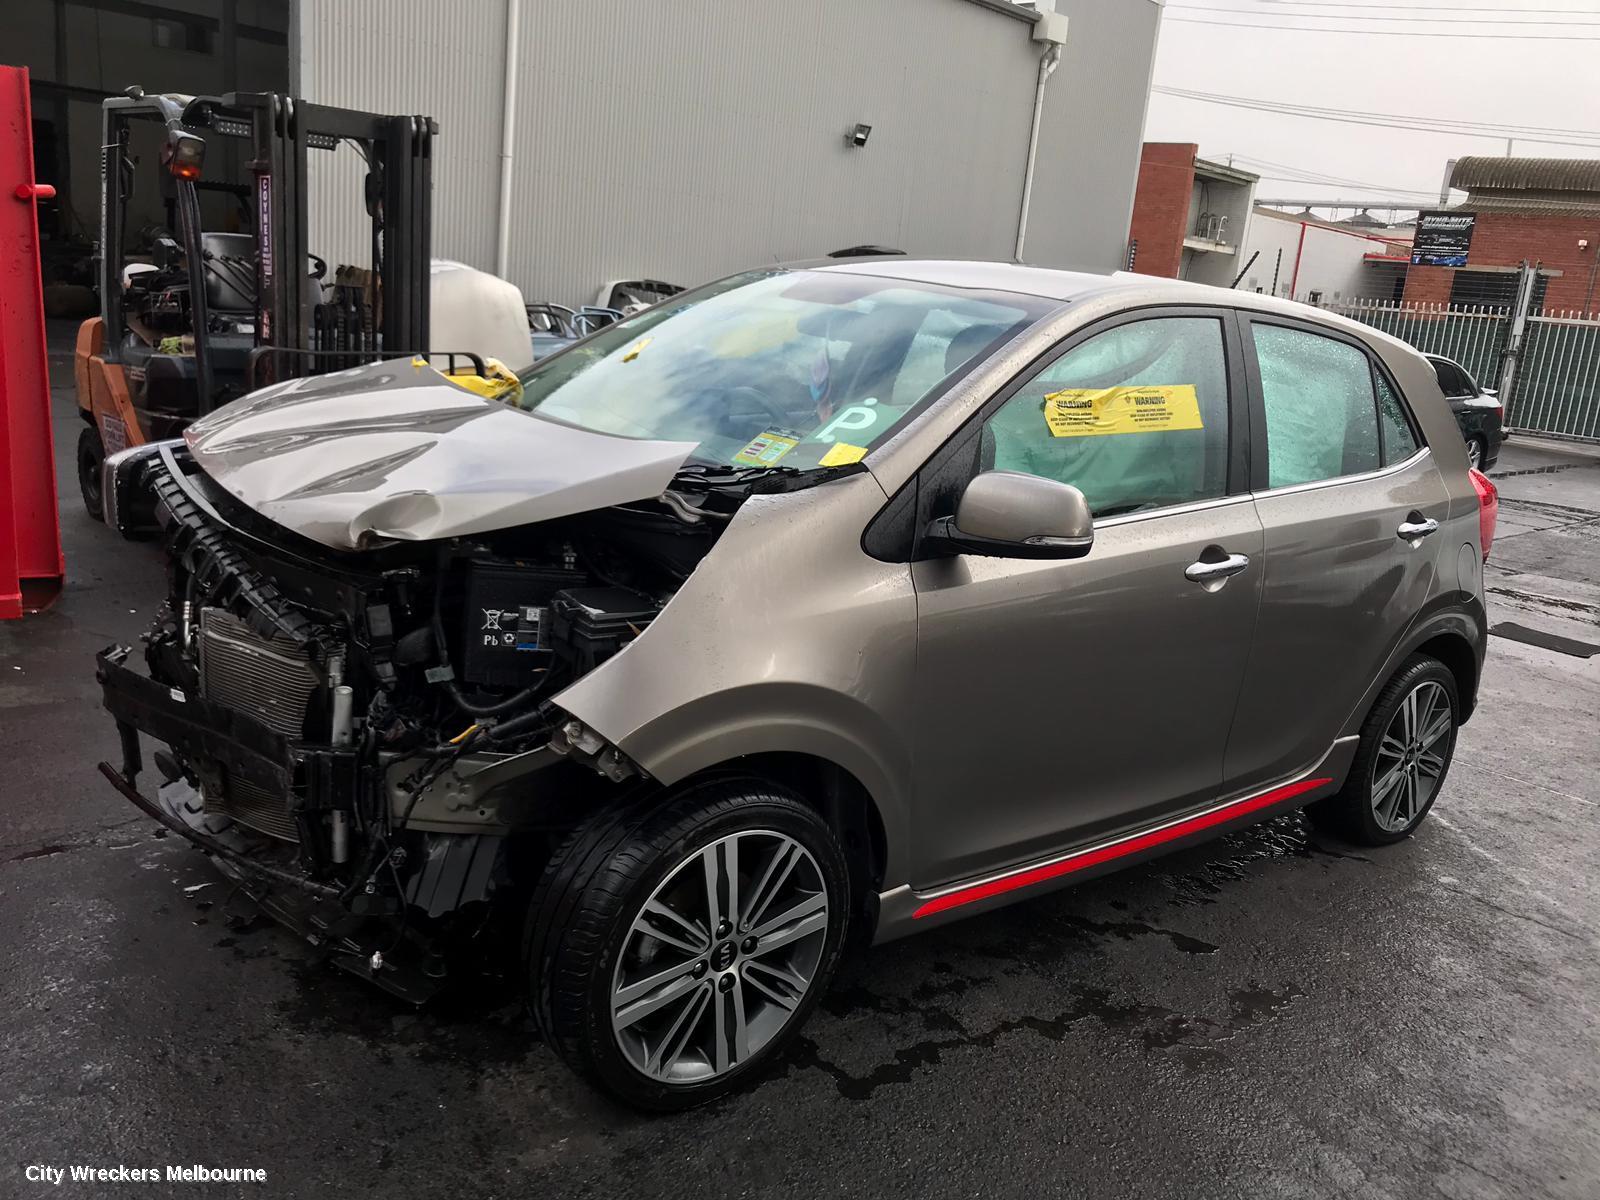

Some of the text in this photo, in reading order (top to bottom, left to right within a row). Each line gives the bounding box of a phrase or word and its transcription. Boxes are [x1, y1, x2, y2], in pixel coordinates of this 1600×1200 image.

[1056, 399, 1093, 409] WARNING
[1135, 396, 1166, 406] WARNING
[815, 406, 878, 439] P
[484, 634, 499, 646] Pb
